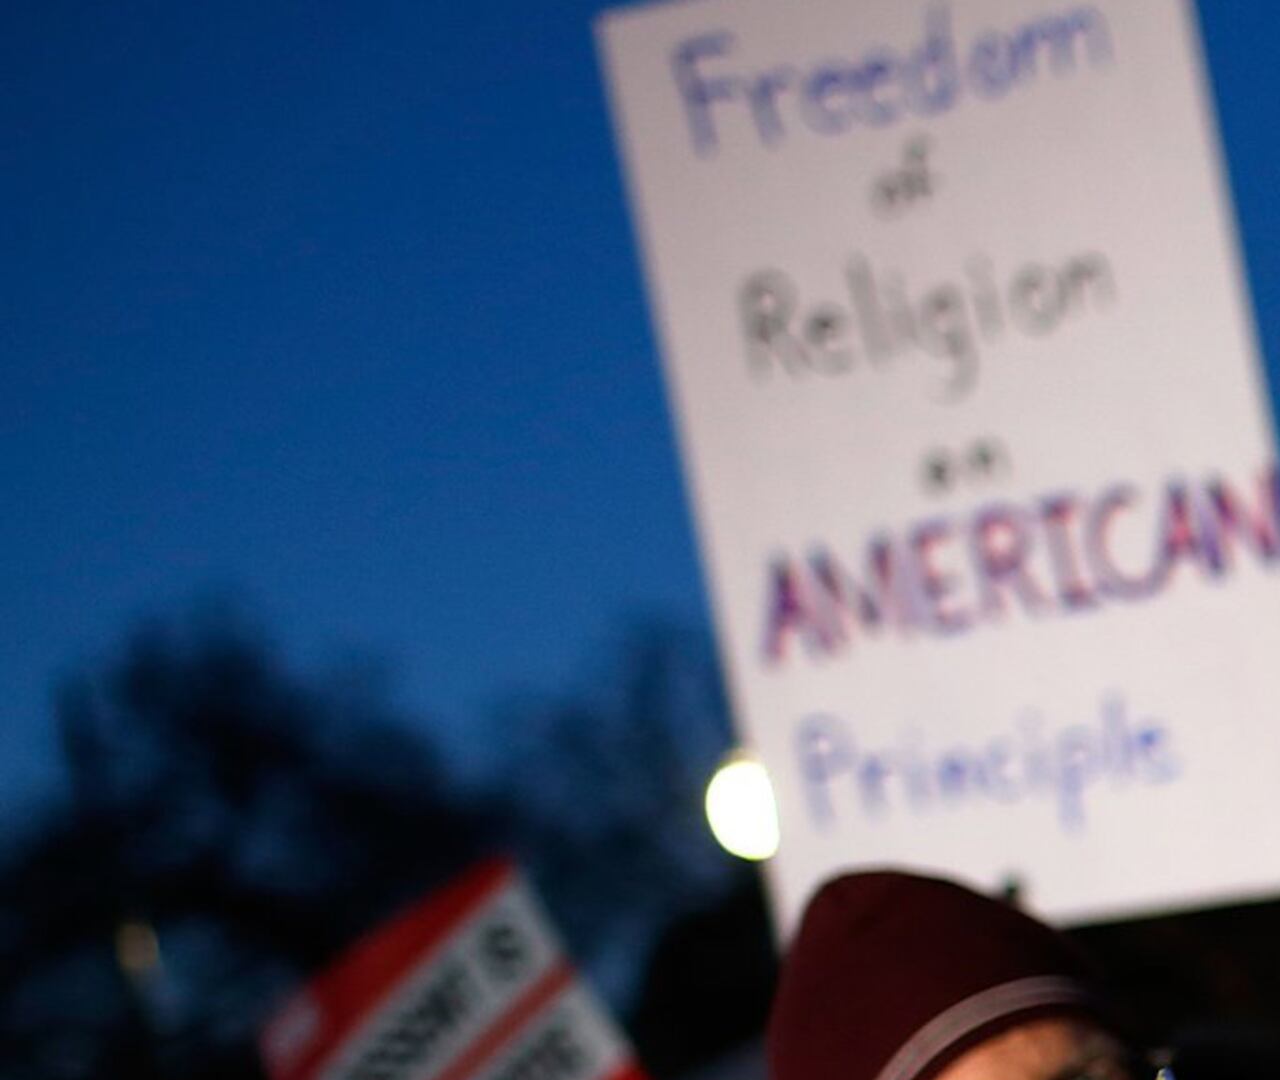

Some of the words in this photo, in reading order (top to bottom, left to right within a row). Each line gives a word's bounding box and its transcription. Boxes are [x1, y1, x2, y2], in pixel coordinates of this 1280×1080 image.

[670, 0, 1116, 158] Freedom
[736, 248, 1120, 398] Religion
[793, 688, 1180, 832] Principle
